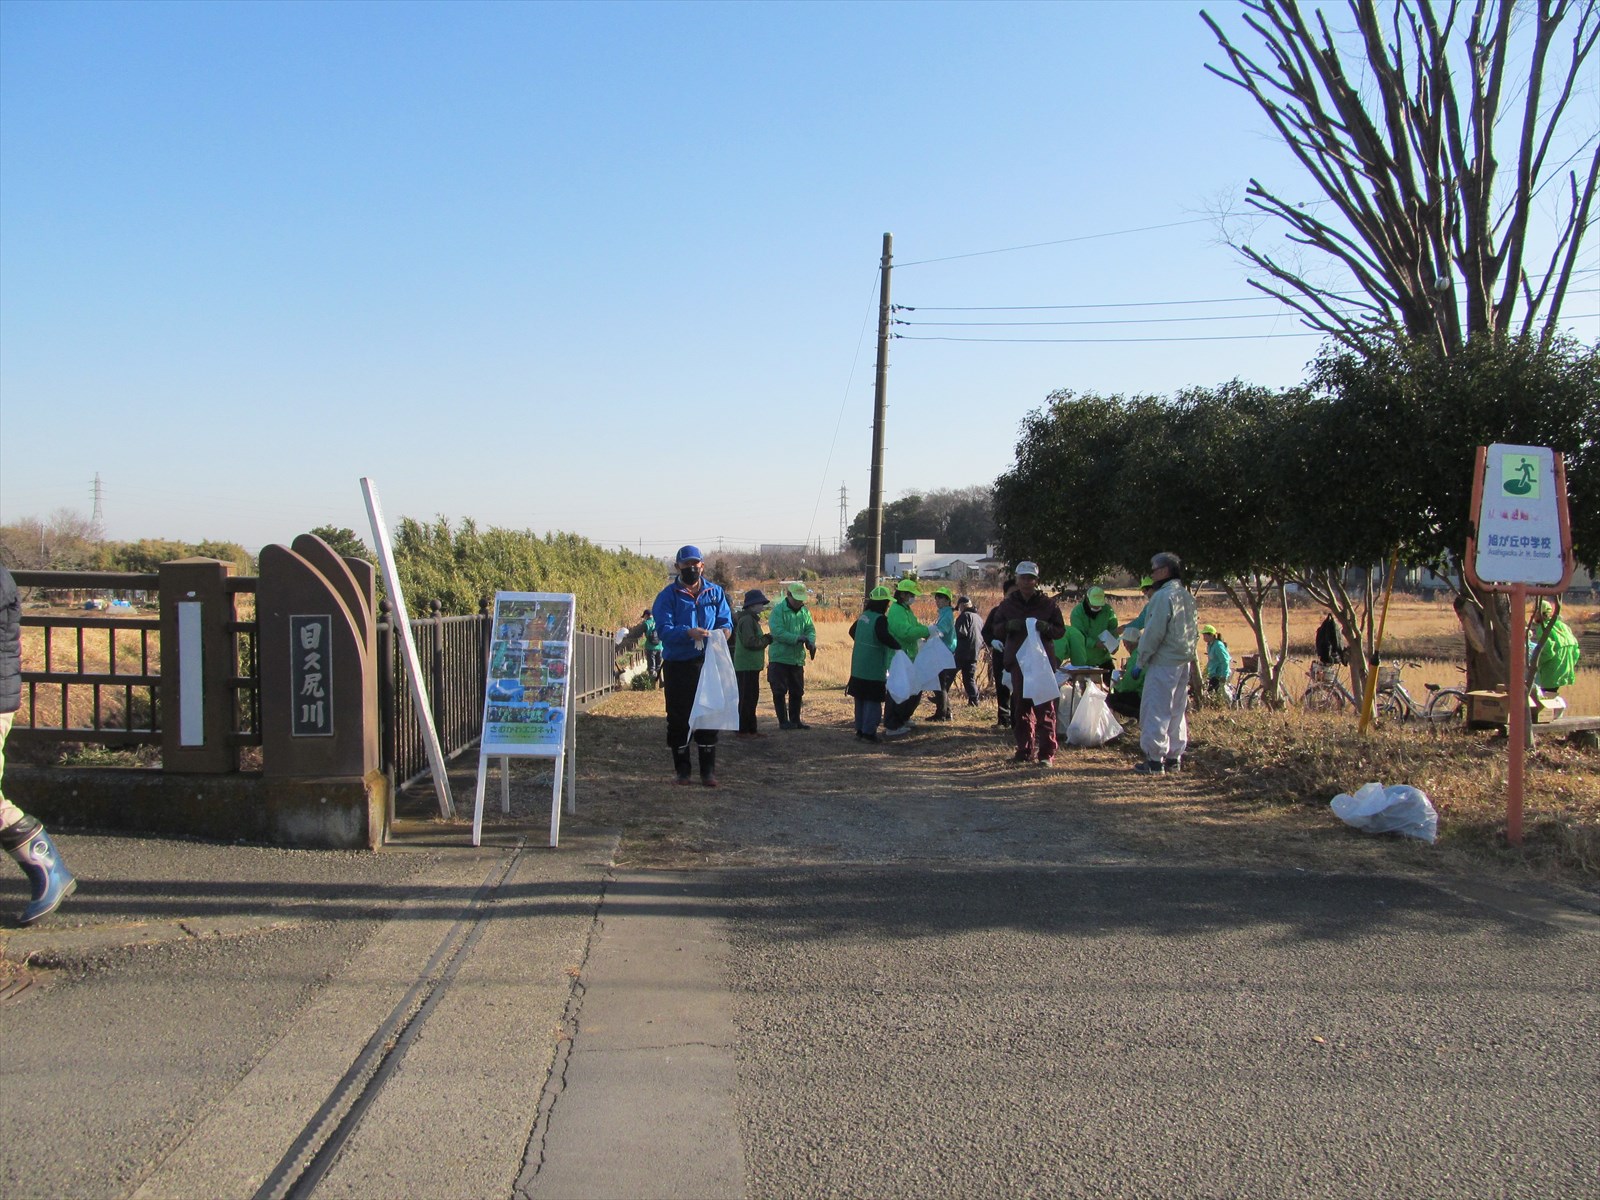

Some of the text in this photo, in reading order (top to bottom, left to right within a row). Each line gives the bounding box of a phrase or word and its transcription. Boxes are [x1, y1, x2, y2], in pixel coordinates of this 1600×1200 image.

[1488, 534, 1551, 549] 旭が丘中学校
[301, 623, 325, 728] 目久尻川
[490, 725, 557, 734] さむかわエコネット
